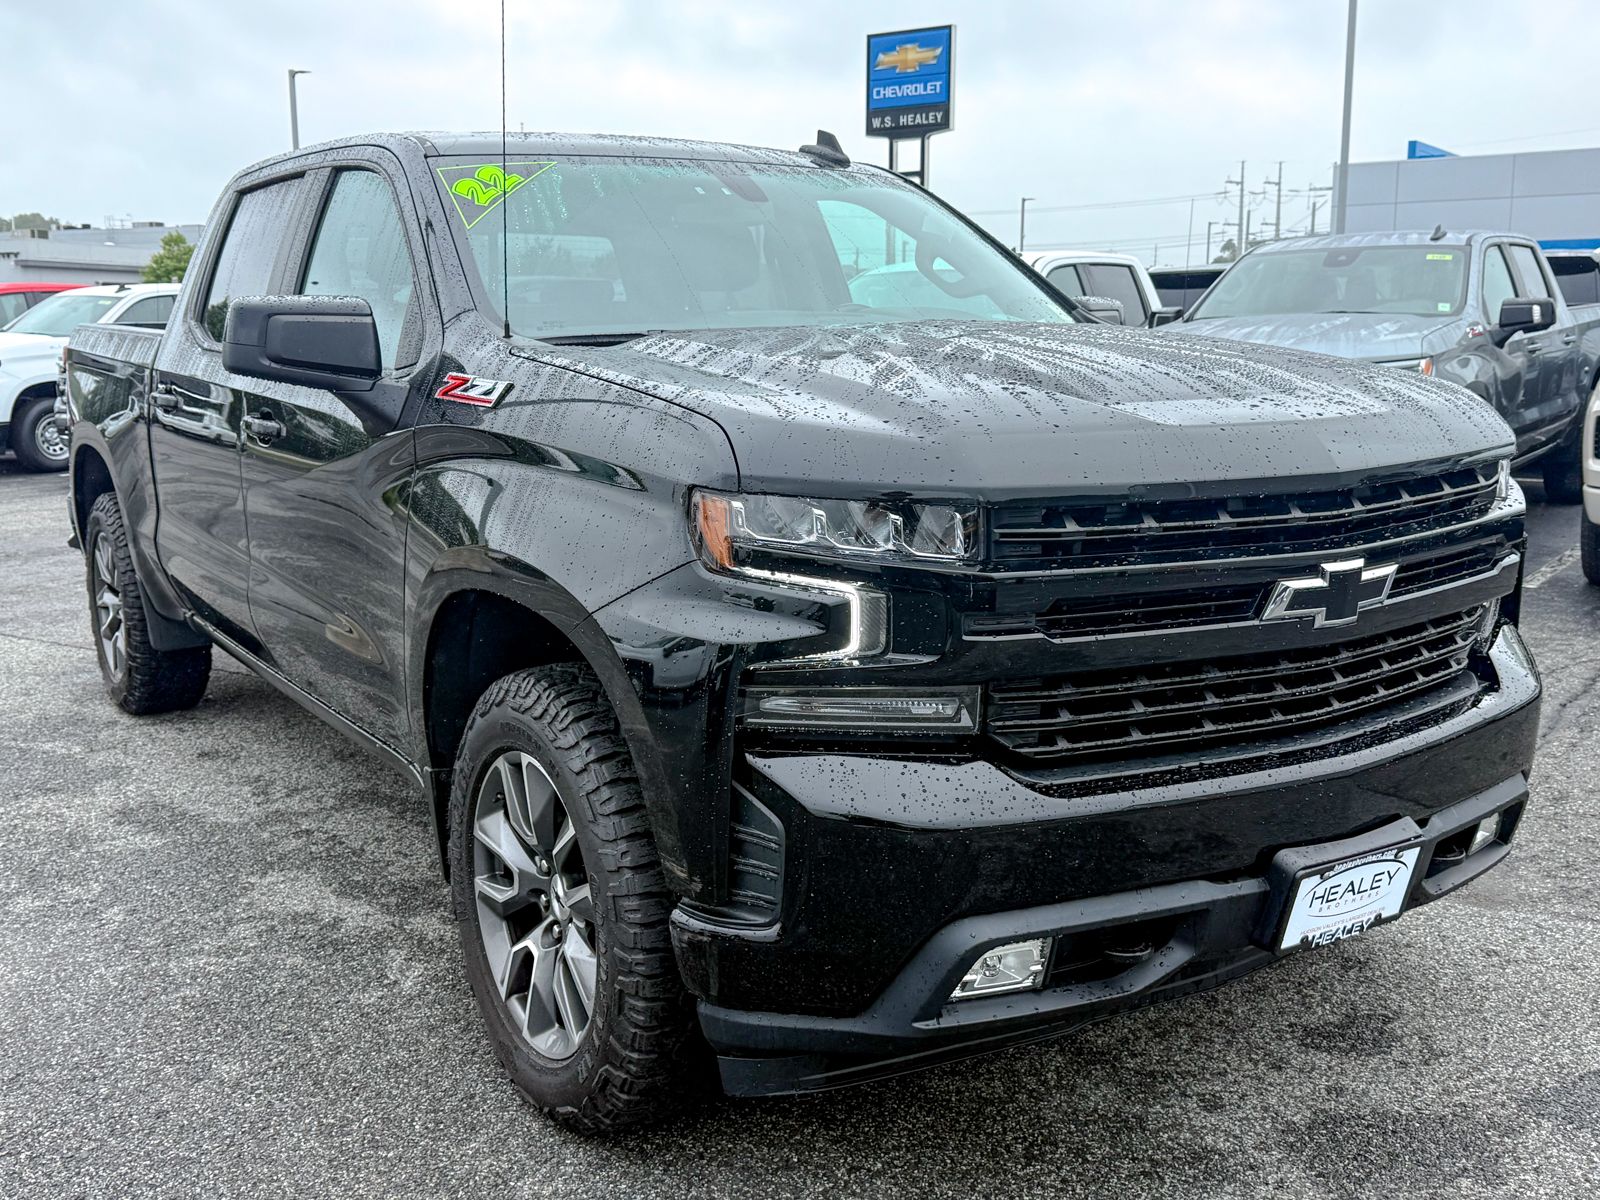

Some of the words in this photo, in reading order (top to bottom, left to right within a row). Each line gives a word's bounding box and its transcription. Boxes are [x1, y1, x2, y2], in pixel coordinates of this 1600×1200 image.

[873, 81, 943, 99] CHEVROLET
[872, 116, 895, 128] W.S.
[900, 111, 943, 126] HEALEY
[452, 165, 525, 207] 22
[435, 372, 515, 409] Z71
[1308, 867, 1401, 909] HEALEY
[1318, 891, 1380, 913] BROTHERS
[1311, 919, 1372, 948] HEALEY
